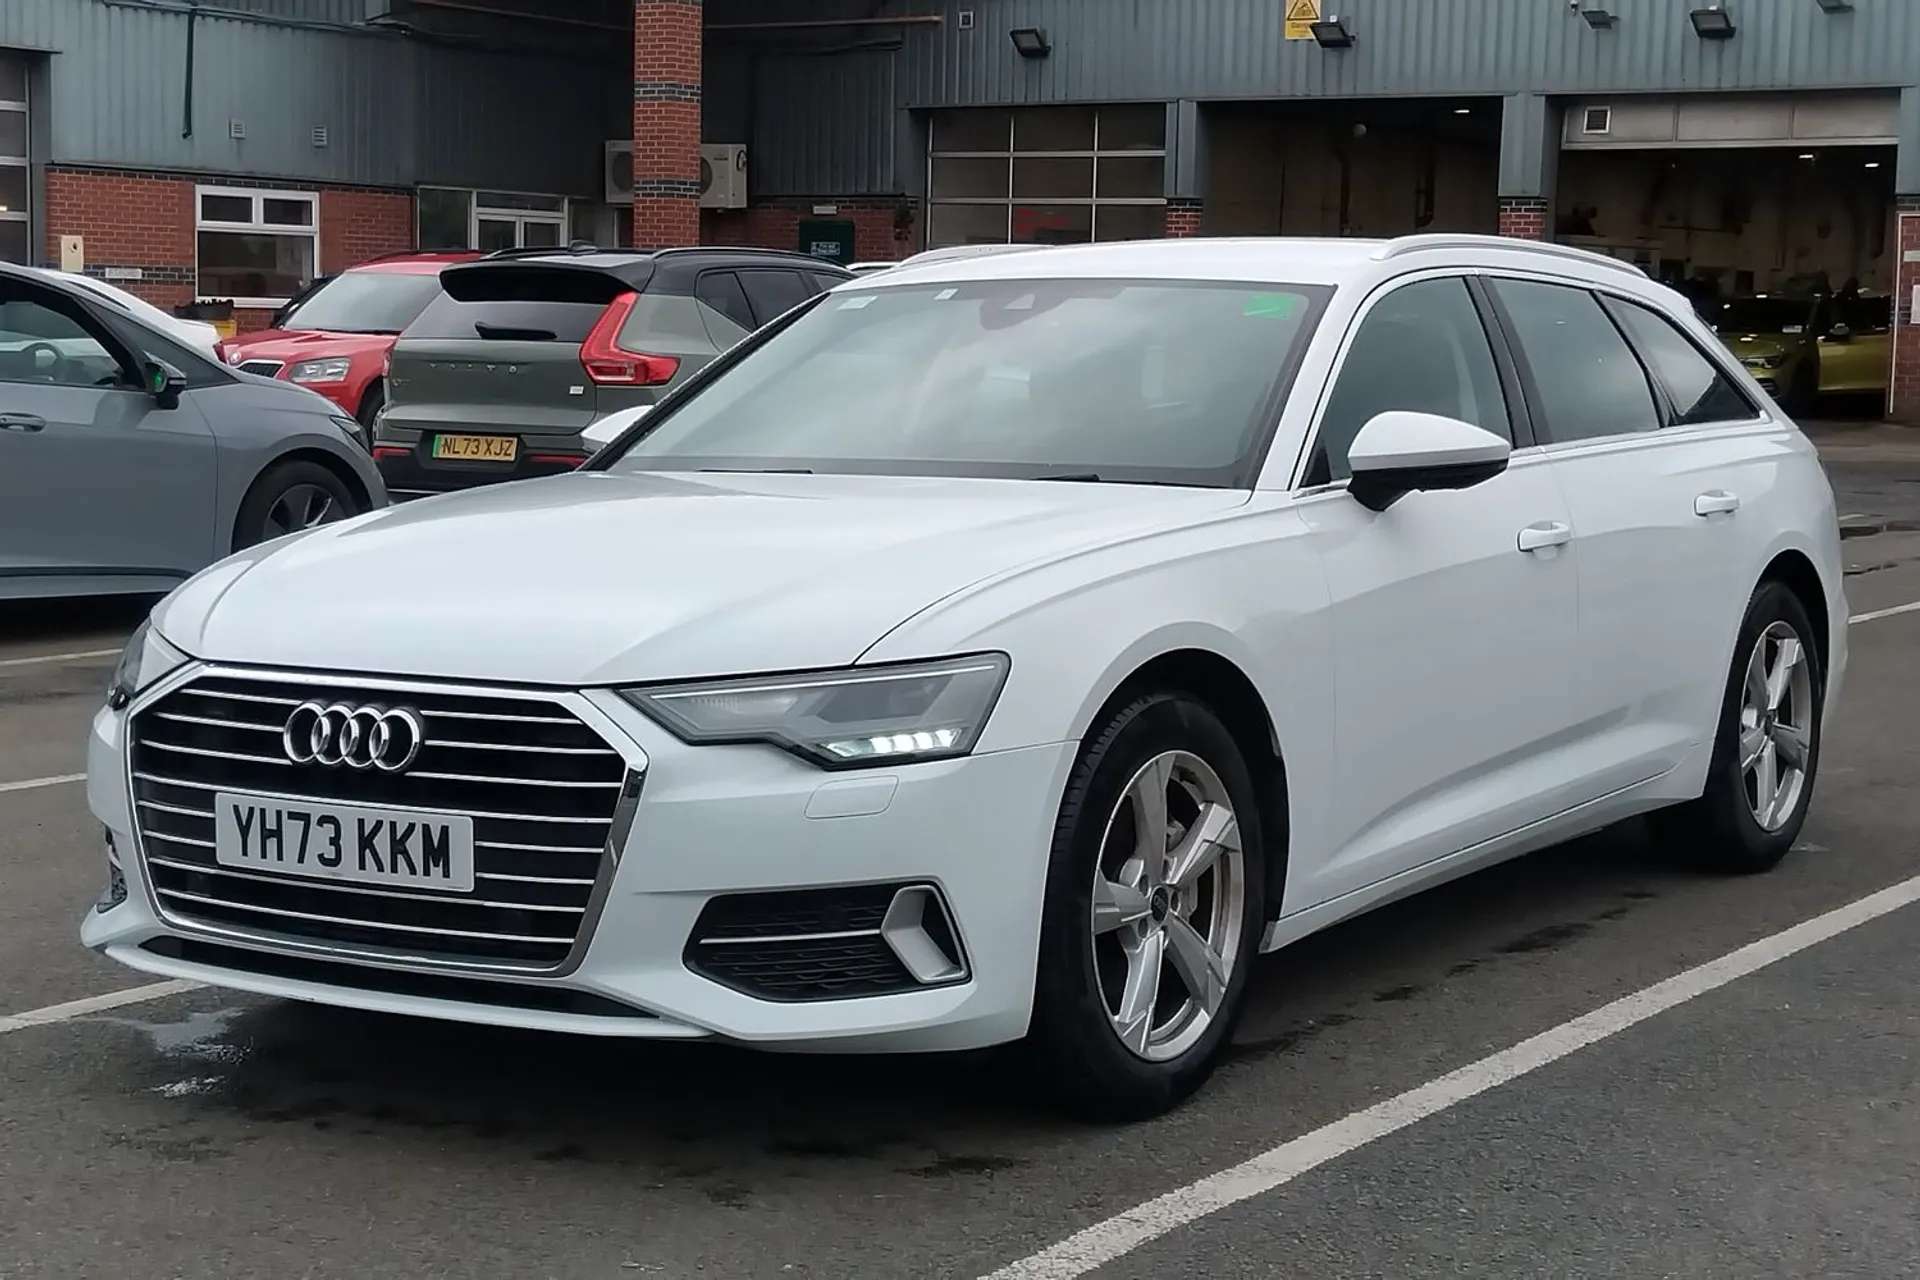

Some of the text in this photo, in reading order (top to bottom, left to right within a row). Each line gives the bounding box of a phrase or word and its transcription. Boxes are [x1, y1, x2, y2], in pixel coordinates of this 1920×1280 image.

[442, 437, 513, 457] NL73 XJZ
[232, 803, 450, 879] YH73 KKM
